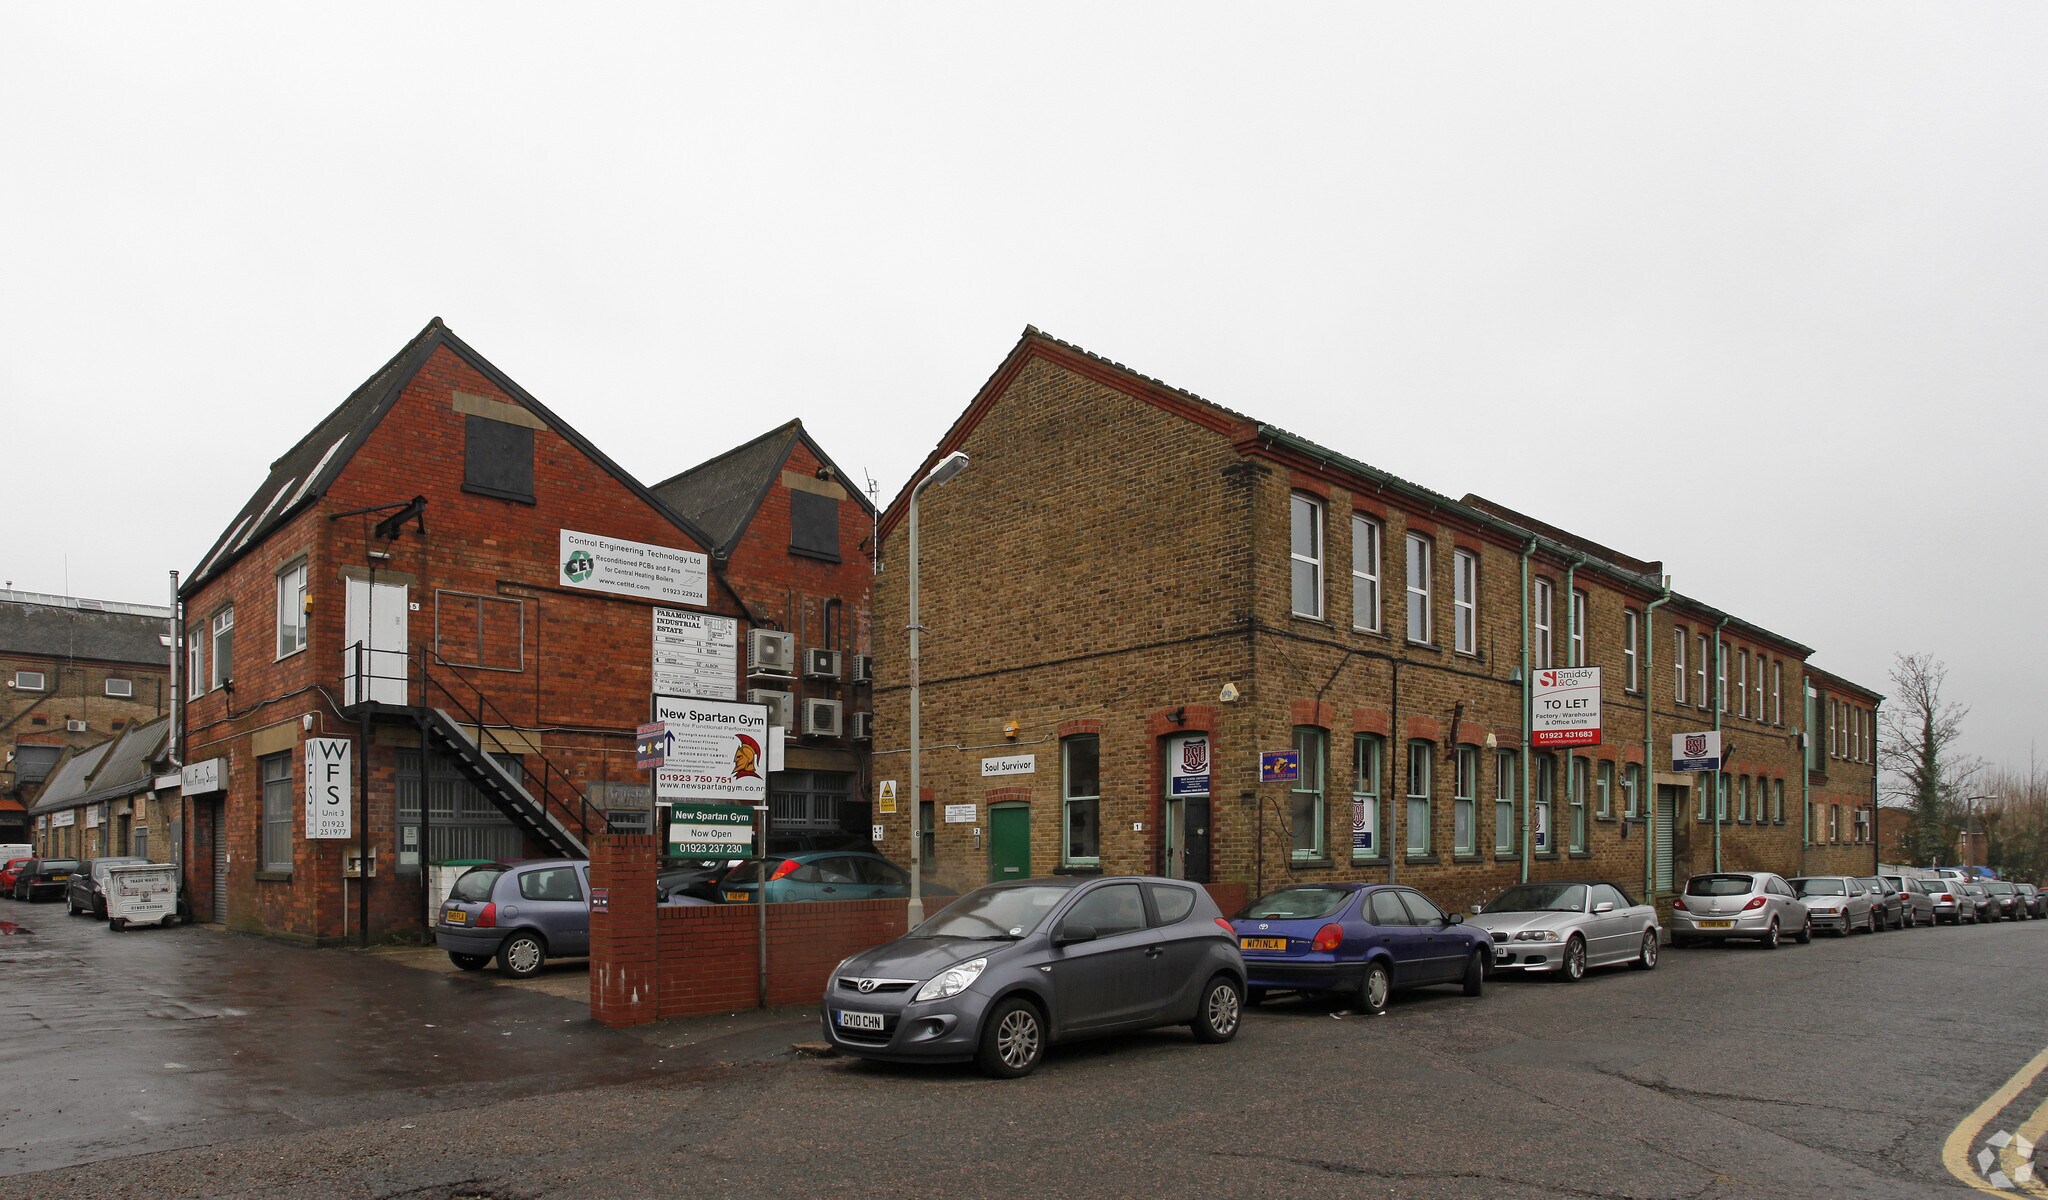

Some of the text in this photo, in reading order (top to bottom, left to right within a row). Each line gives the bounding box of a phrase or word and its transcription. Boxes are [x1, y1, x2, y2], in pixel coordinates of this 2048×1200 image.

[568, 535, 701, 565] Control Engineering Technology Ltd
[595, 554, 638, 567] Reconditioned
[638, 561, 655, 570] PCBs
[667, 565, 681, 574] Fans
[613, 567, 634, 576] Central
[634, 571, 655, 581] Heating
[655, 574, 674, 583] Boilers
[598, 578, 651, 591] www.cetltd.com
[662, 587, 703, 599] 01923 229224
[656, 609, 701, 621] PARAMOUNT
[656, 617, 701, 629] INDUSTRIAL
[656, 625, 684, 635] ESTATE
[1557, 669, 1593, 679] Smiddy
[1544, 698, 1589, 710] TO LET
[660, 707, 764, 727] New Spartan Gym
[724, 725, 761, 733] Performance
[1564, 730, 1593, 738] 431683
[1685, 738, 1706, 754] BSU
[1184, 746, 1206, 767] BSU
[985, 760, 1031, 772] Soul Survivor
[659, 773, 732, 784] 01923 750 751
[659, 782, 765, 793] www.newspartangym.co.nr
[675, 810, 749, 823] New Spartan Gym
[322, 820, 345, 828] 01923
[320, 828, 347, 836] 251977
[690, 829, 732, 839] Now Open
[679, 843, 743, 853] 01923 237 230
[843, 1013, 880, 1029] GY10 CHN
